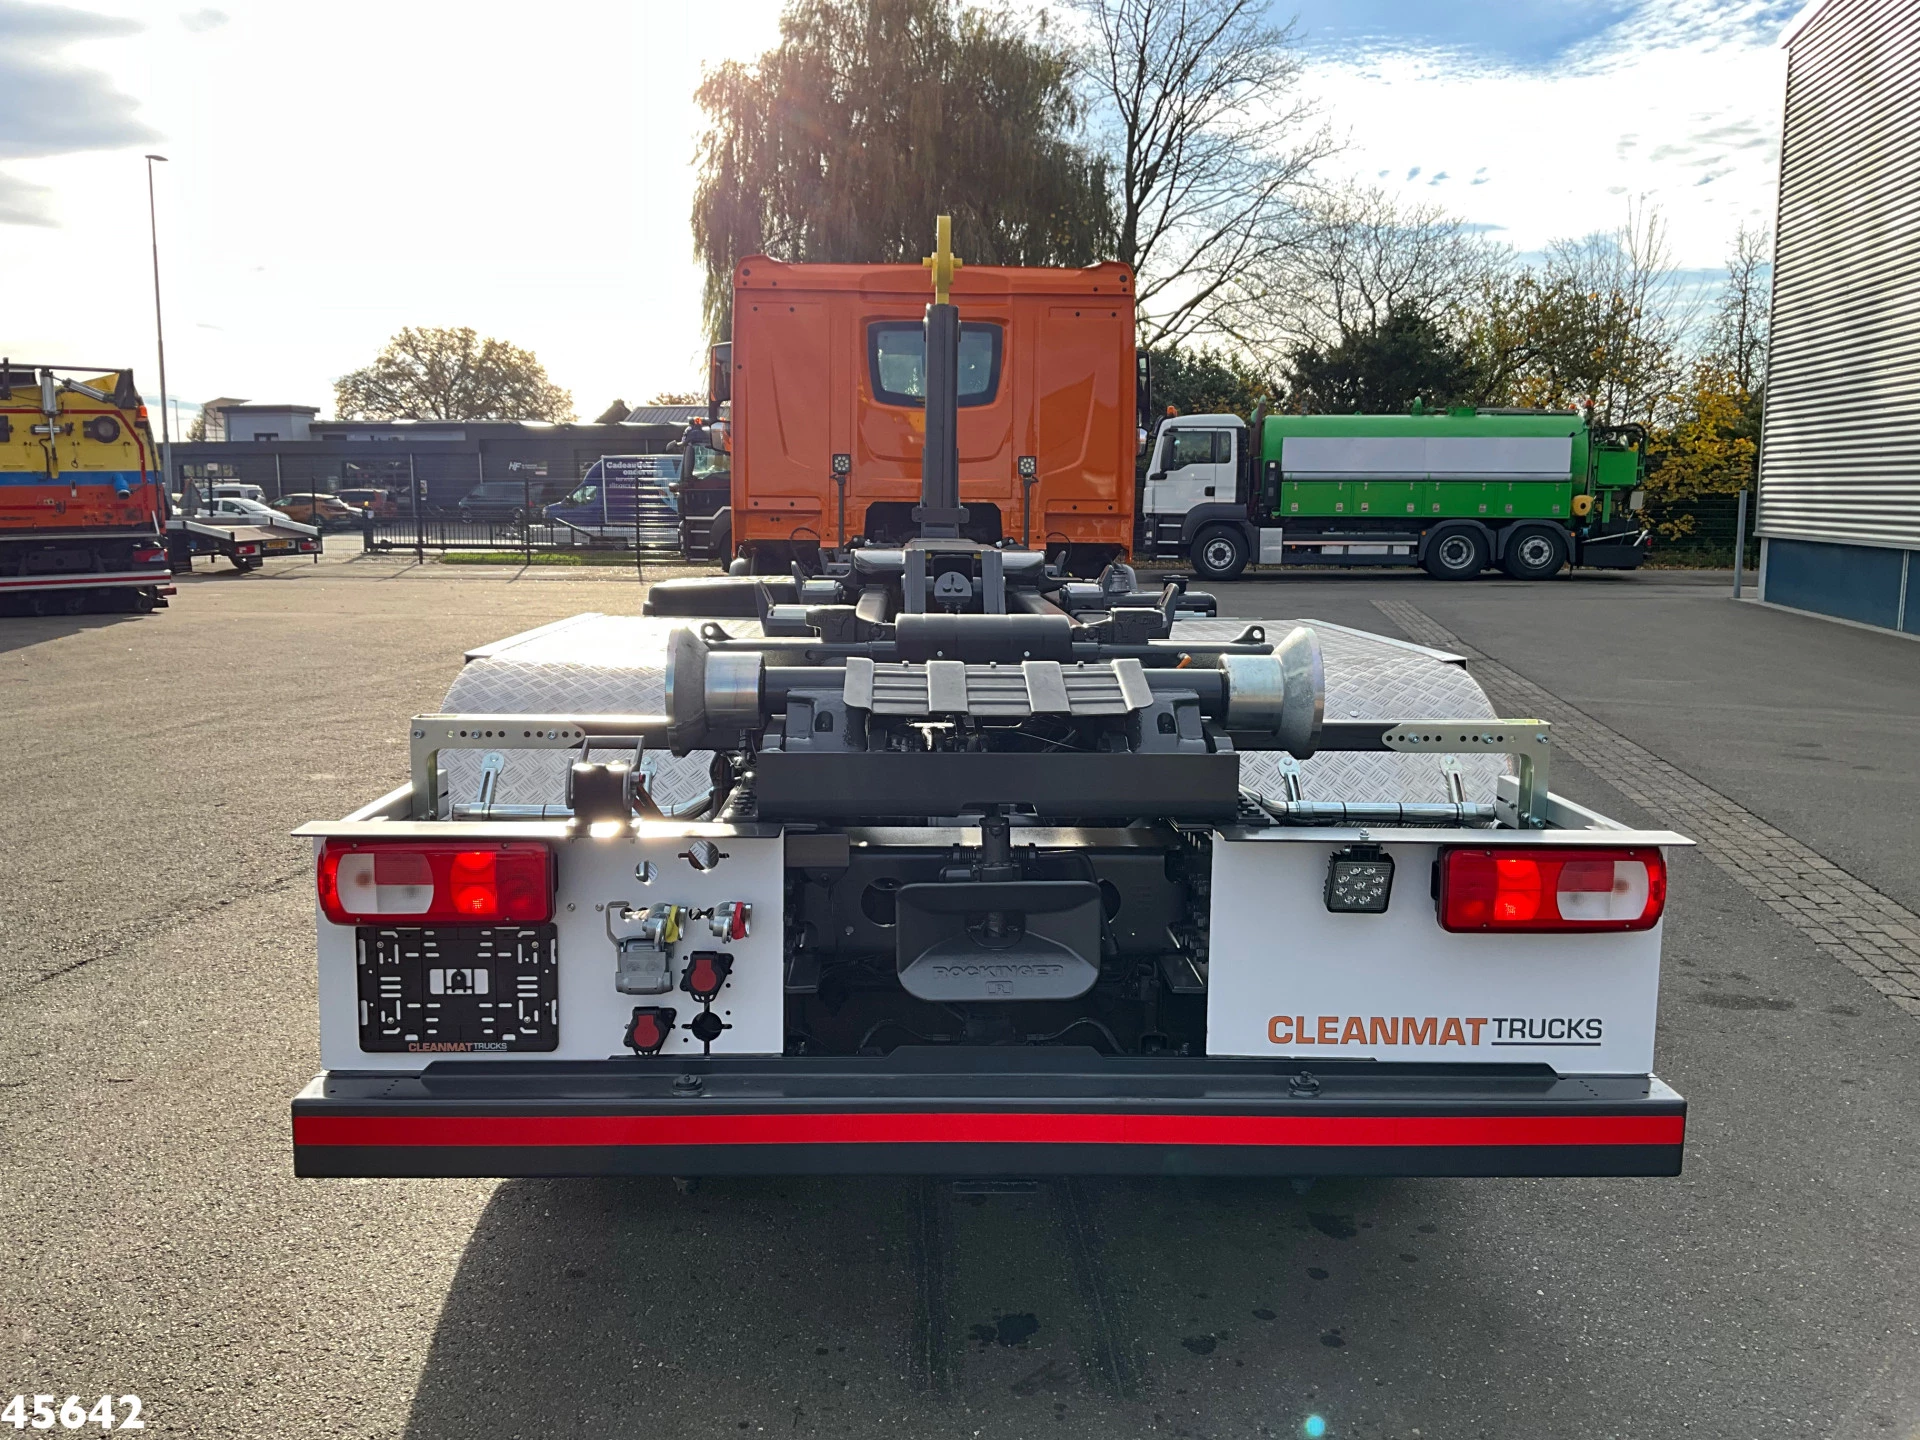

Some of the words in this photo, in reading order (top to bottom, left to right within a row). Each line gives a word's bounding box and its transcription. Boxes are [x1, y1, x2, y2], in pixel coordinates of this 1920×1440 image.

[932, 964, 1064, 978] ROCKINGER
[1267, 1015, 1488, 1046] CLEANMAT
[1491, 1017, 1603, 1040] TRUCKS
[408, 1042, 473, 1052] CLEANMAT
[473, 1042, 508, 1051] TRUCKS
